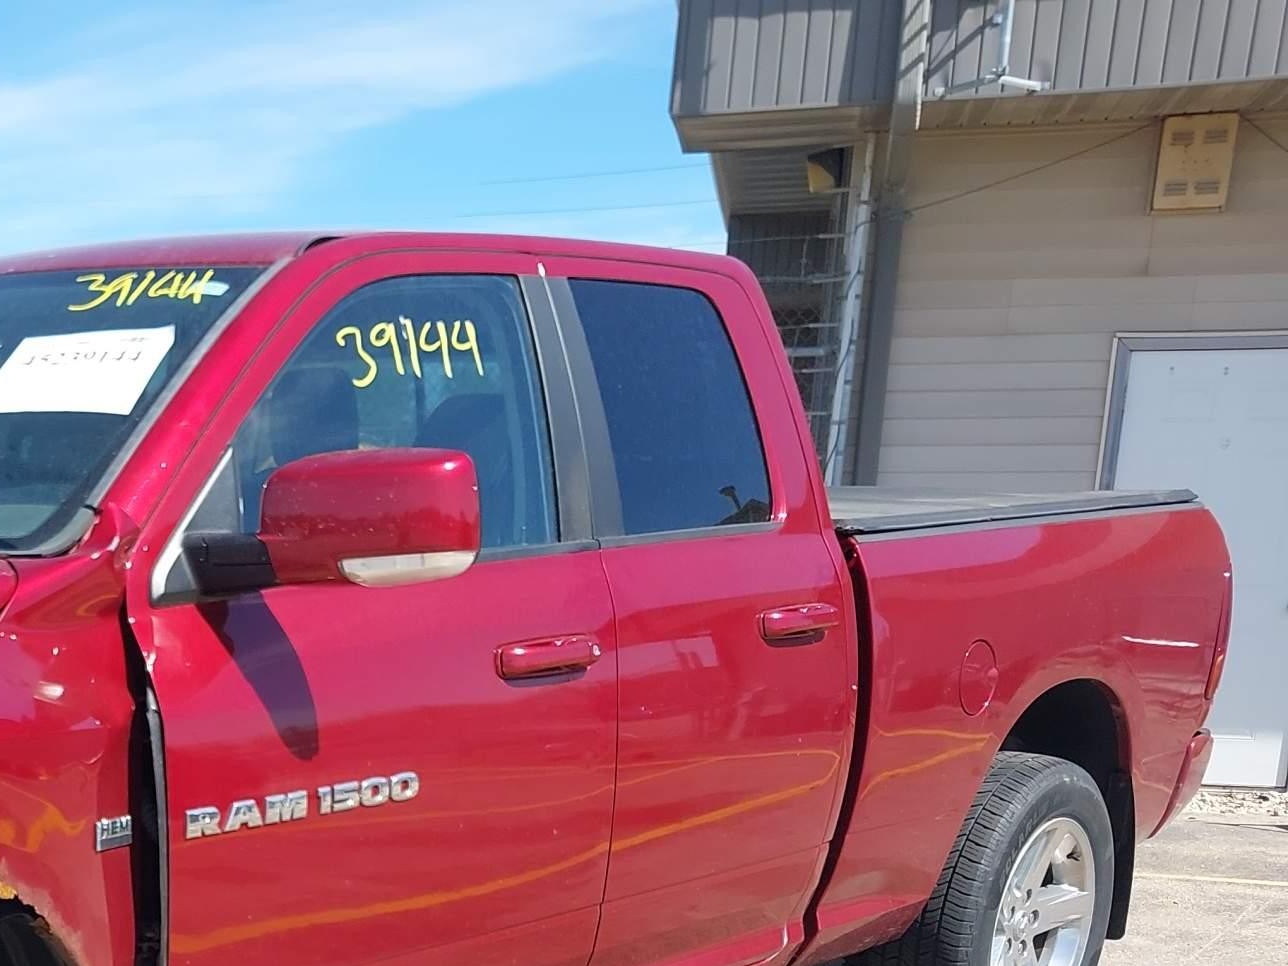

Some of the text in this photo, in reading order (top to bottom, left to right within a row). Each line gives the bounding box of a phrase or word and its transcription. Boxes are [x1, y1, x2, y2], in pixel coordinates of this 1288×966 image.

[336, 317, 484, 388] 39144
[185, 771, 420, 840] RAM 1500
